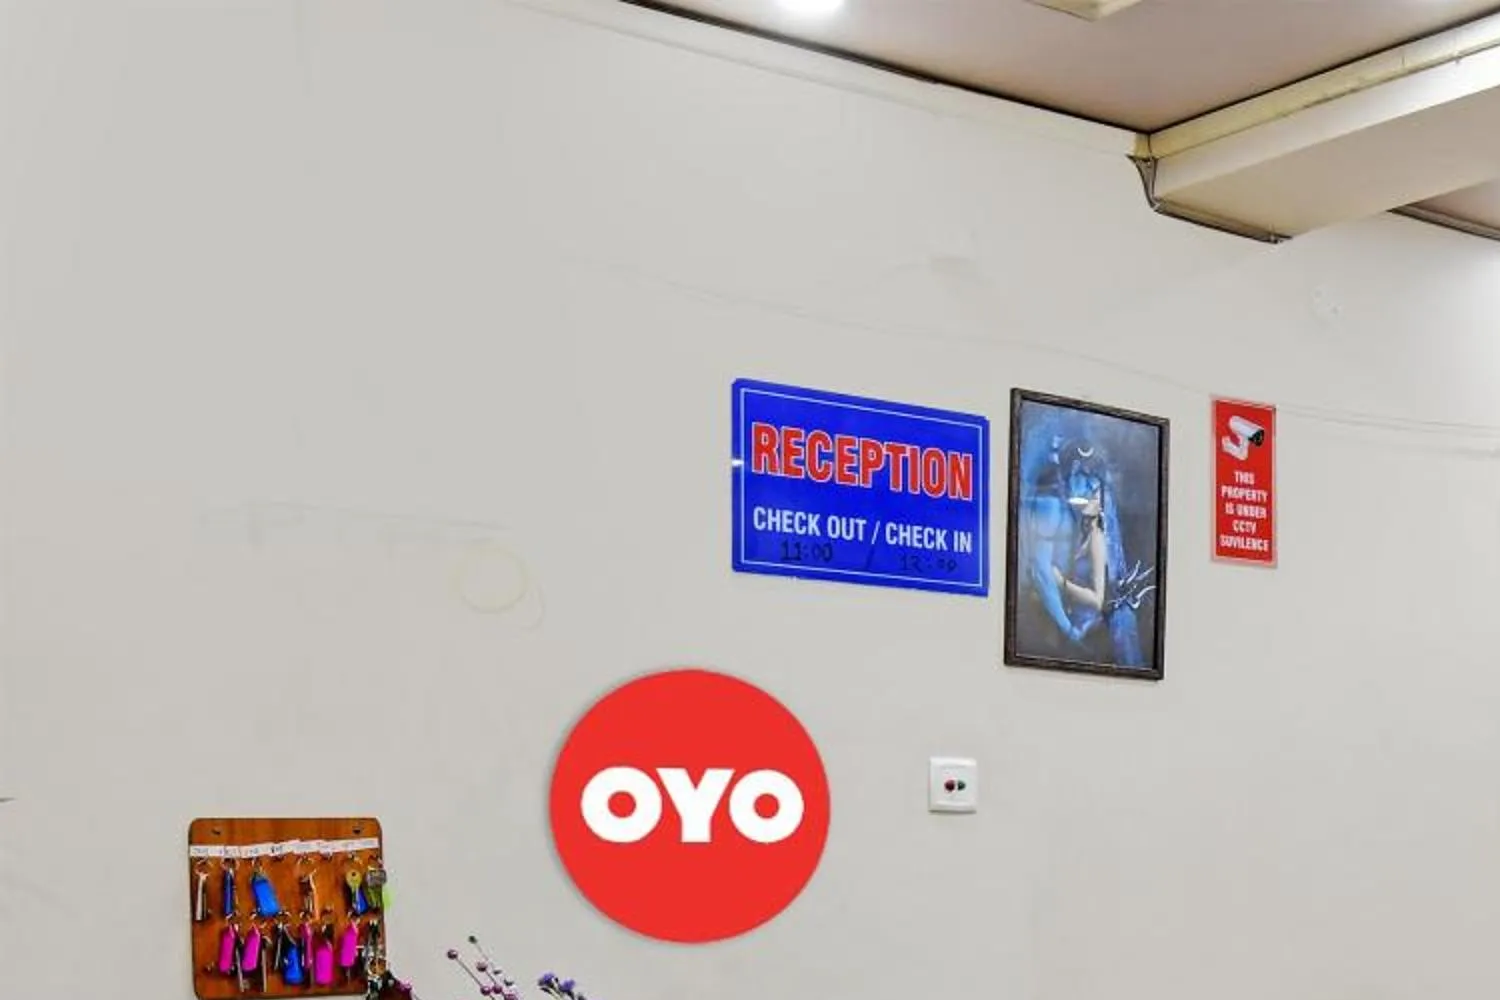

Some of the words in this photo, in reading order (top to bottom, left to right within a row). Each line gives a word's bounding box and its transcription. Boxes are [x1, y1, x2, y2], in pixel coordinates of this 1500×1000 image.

[752, 421, 973, 502] RECEPTION
[1234, 470, 1255, 485] THIS
[1221, 485, 1267, 503] PROPERTY
[1236, 503, 1267, 519] UNDER
[753, 506, 822, 536] CHECK
[827, 515, 868, 542] OUT
[871, 521, 881, 545] /
[885, 522, 948, 551] CHECK
[953, 530, 972, 553] IN
[1232, 519, 1257, 535] CCTV
[580, 766, 805, 843] OYO
